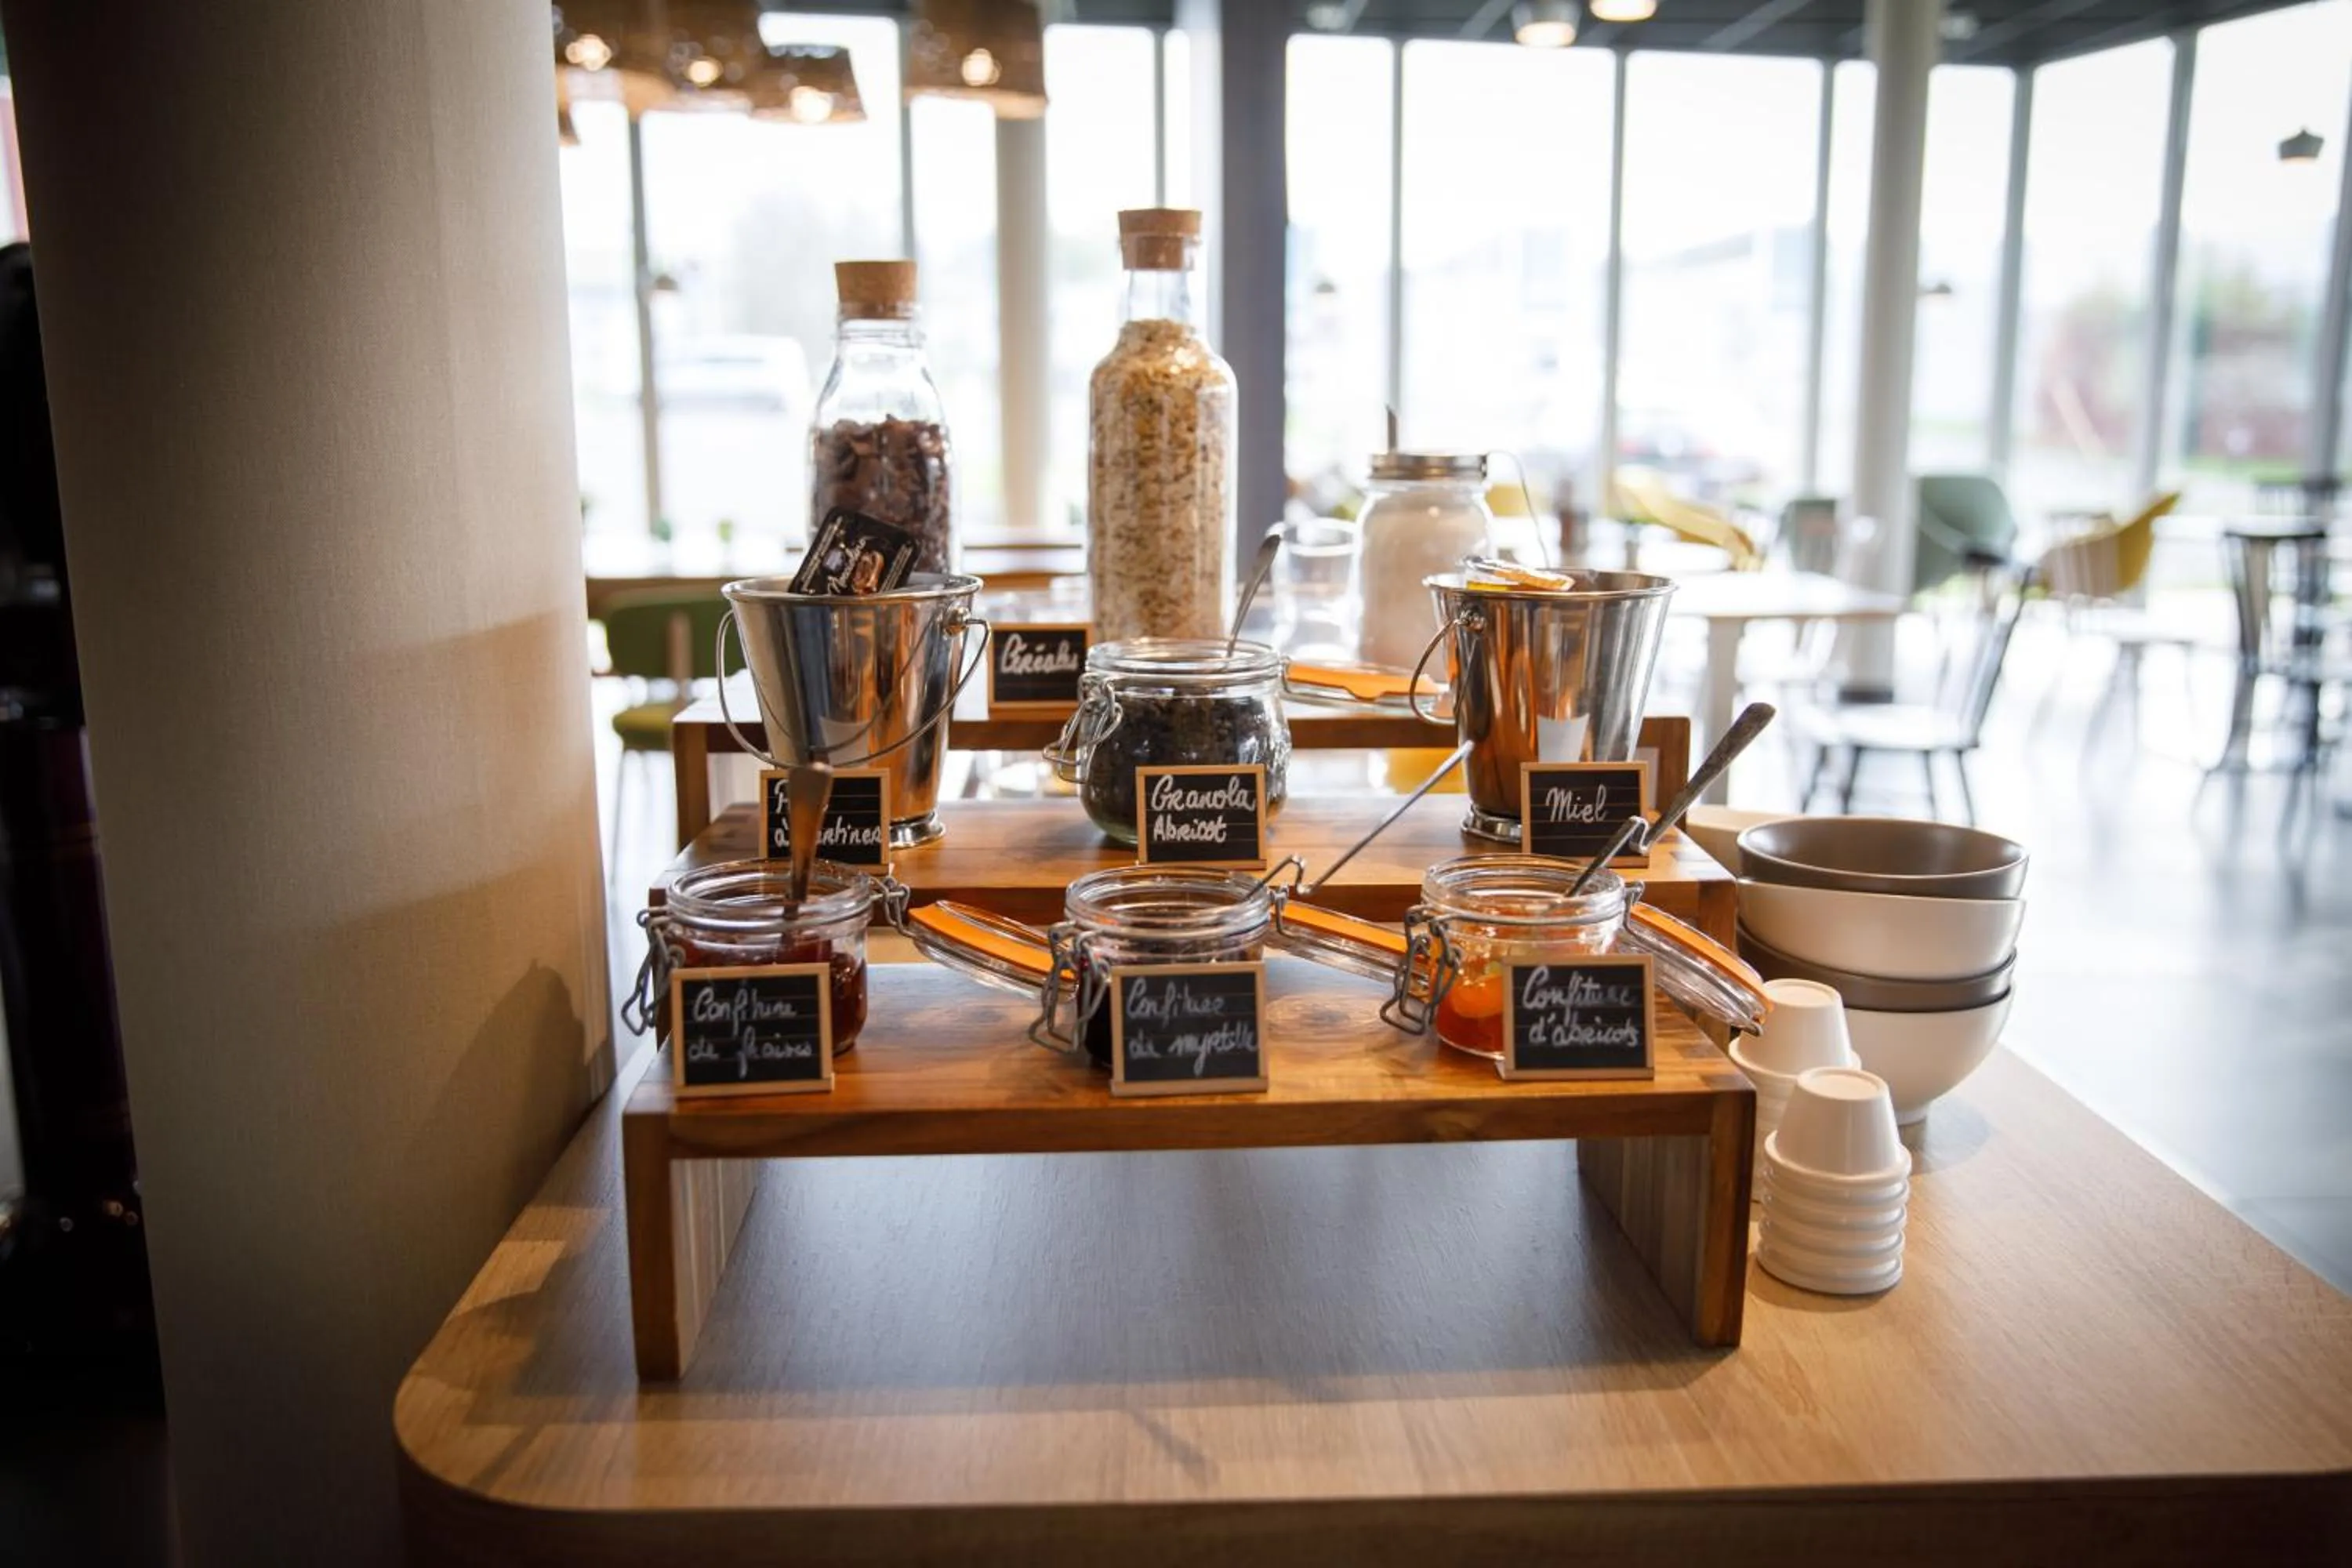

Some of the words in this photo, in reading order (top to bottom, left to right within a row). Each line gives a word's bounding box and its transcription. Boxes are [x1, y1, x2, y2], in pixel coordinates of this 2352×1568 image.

[1151, 774, 1257, 811] Granola
[1545, 783, 1607, 823] Miel
[1153, 813, 1228, 844] Abricot
[1522, 965, 1634, 1028] Confiture
[1128, 1029, 1162, 1059] de
[1529, 1011, 1639, 1048] d'abricots
[688, 1036, 720, 1062] de
